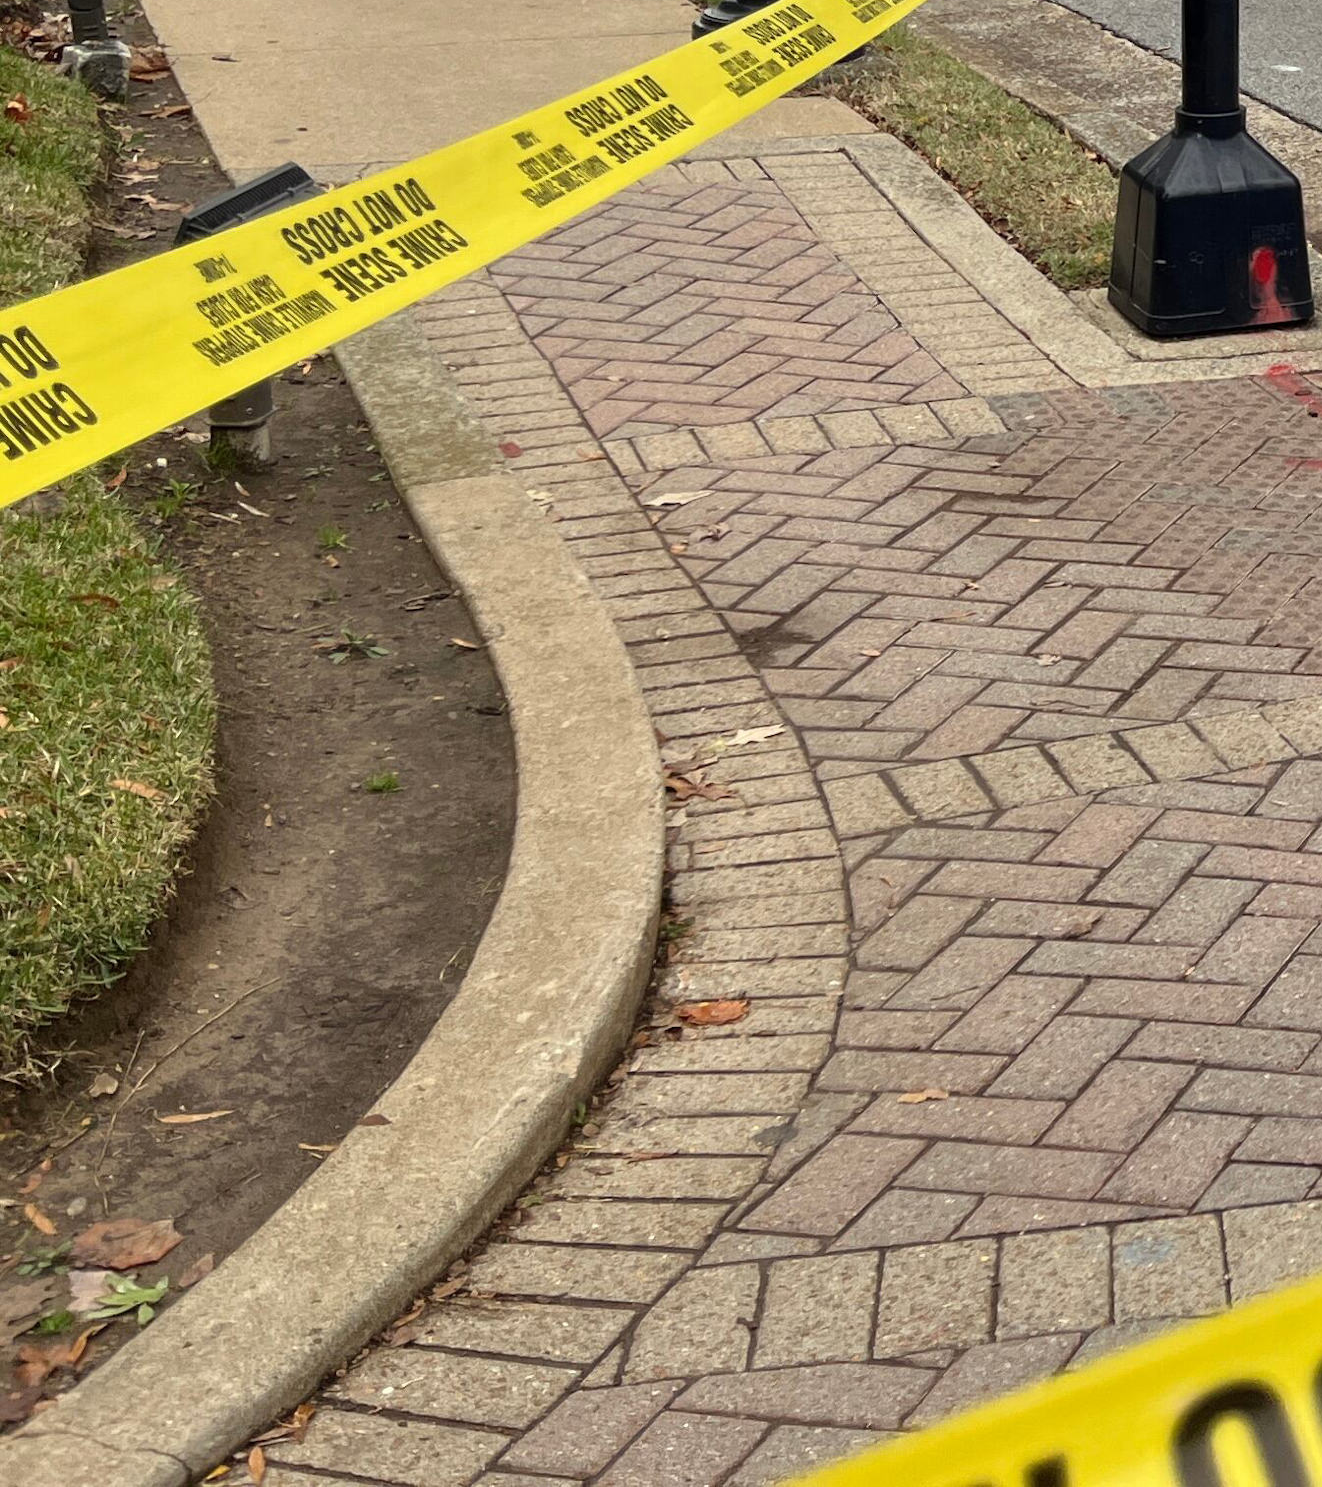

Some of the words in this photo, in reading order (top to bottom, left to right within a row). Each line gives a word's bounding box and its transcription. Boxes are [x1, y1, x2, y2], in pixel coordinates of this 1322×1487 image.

[608, 83, 651, 116] NOT
[634, 74, 668, 102] DO
[564, 96, 623, 137] CROSS
[638, 103, 695, 142] CRIME
[596, 124, 656, 164] SCENE
[352, 190, 408, 236] NOT
[393, 177, 436, 217] DO
[281, 207, 365, 265] CROSS
[386, 219, 469, 270] CRIME
[319, 247, 408, 302] SCENE
